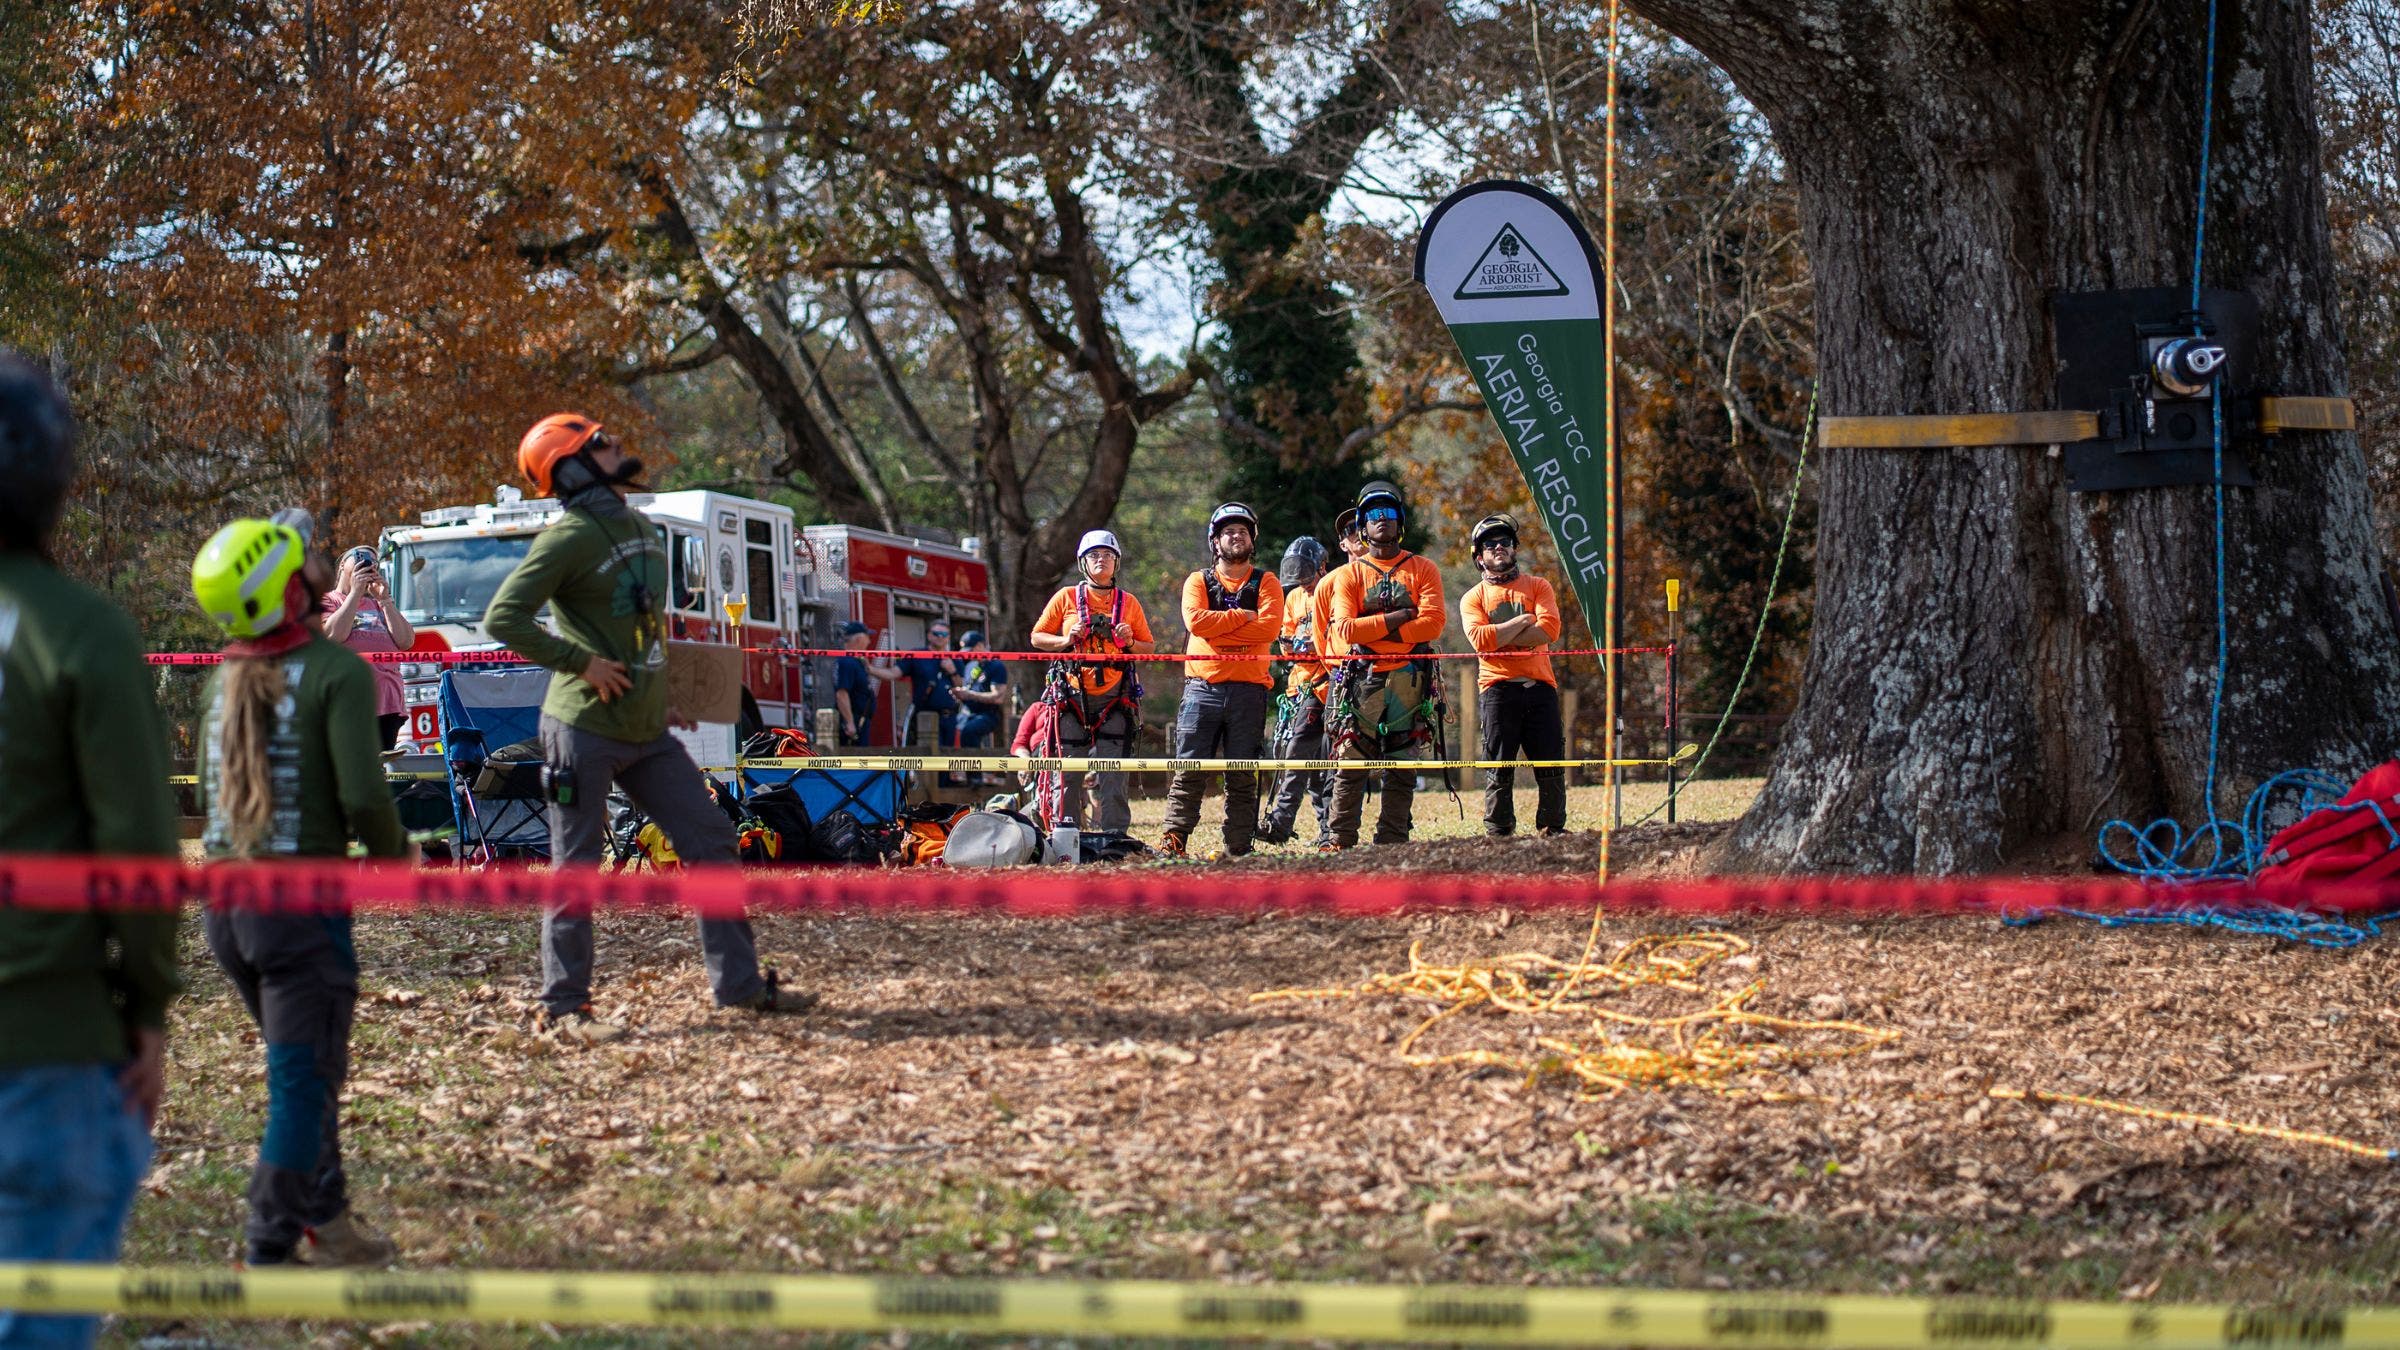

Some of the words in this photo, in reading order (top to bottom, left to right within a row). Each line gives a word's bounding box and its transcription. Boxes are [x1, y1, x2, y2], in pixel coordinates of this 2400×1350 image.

[1479, 272, 1543, 285] ARBORIST
[1482, 263, 1539, 275] GEORGIA
[1517, 333, 1564, 415] Georgia
[1560, 415, 1591, 464] TCC
[1475, 354, 1545, 456] AERIAL
[1533, 458, 1606, 584] RESCUE
[417, 711, 433, 736] 6
